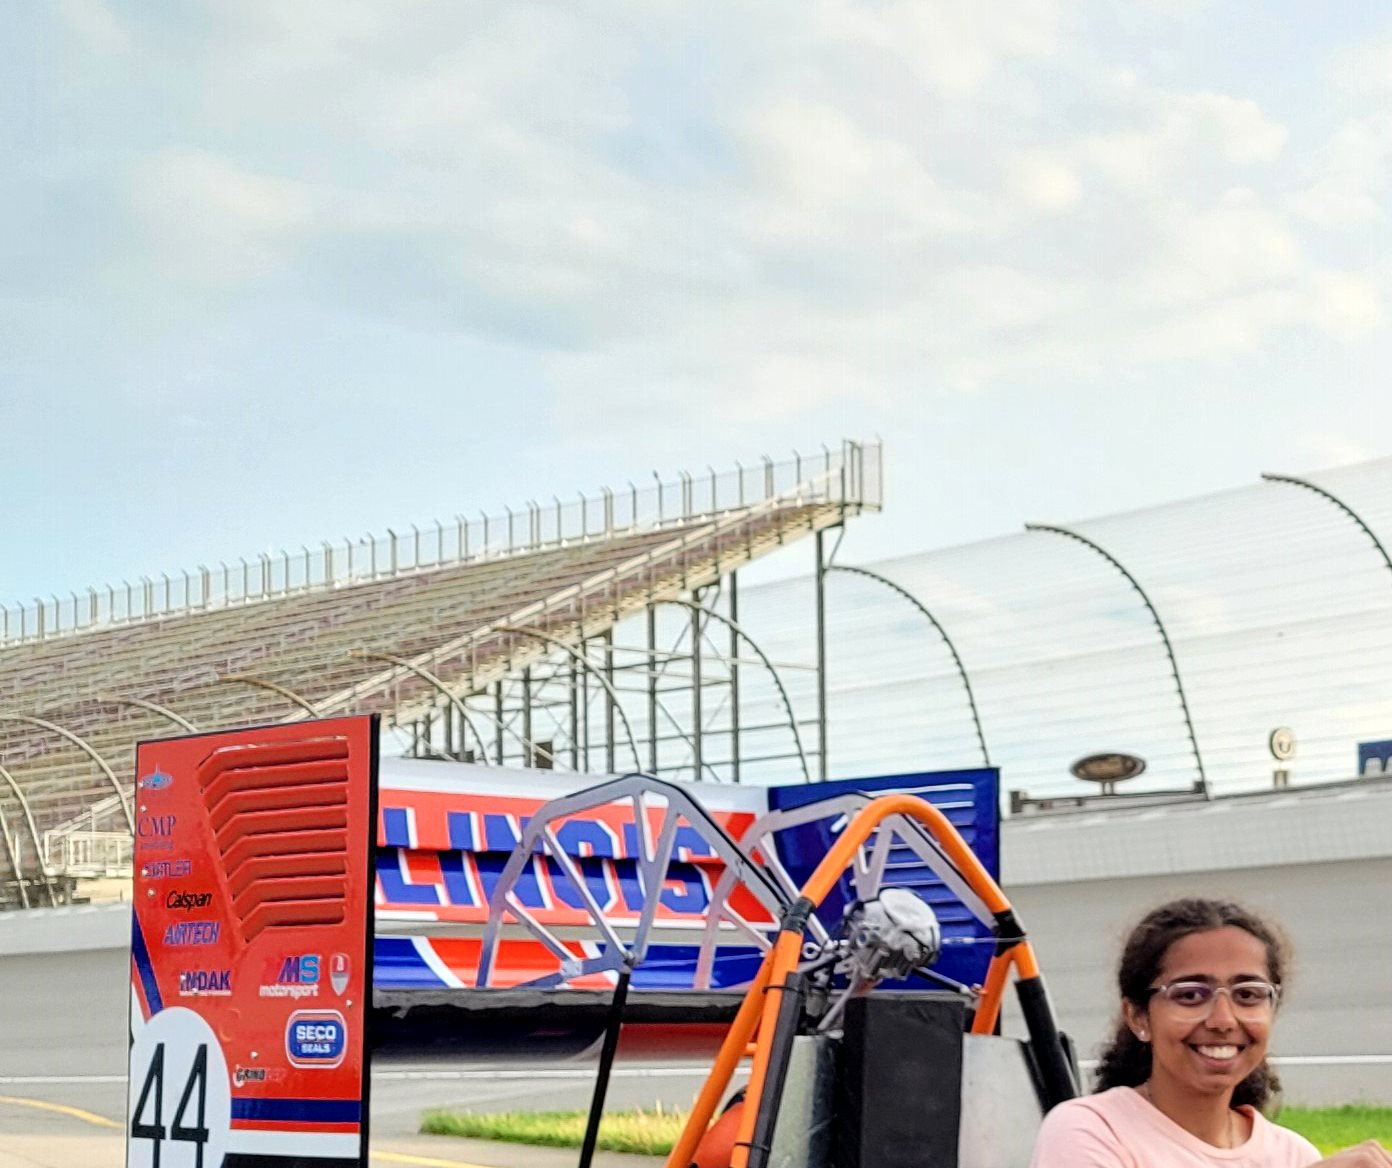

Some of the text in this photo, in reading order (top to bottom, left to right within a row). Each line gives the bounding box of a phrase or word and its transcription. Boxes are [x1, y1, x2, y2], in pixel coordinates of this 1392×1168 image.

[374, 807, 720, 914] LINOIS
[166, 889, 212, 913] Calspan
[164, 921, 221, 945] AIRTECH
[278, 955, 321, 983] MS
[259, 984, 319, 1000] motorsport
[296, 1025, 336, 1040] SECO
[301, 1044, 331, 1054] SEALS
